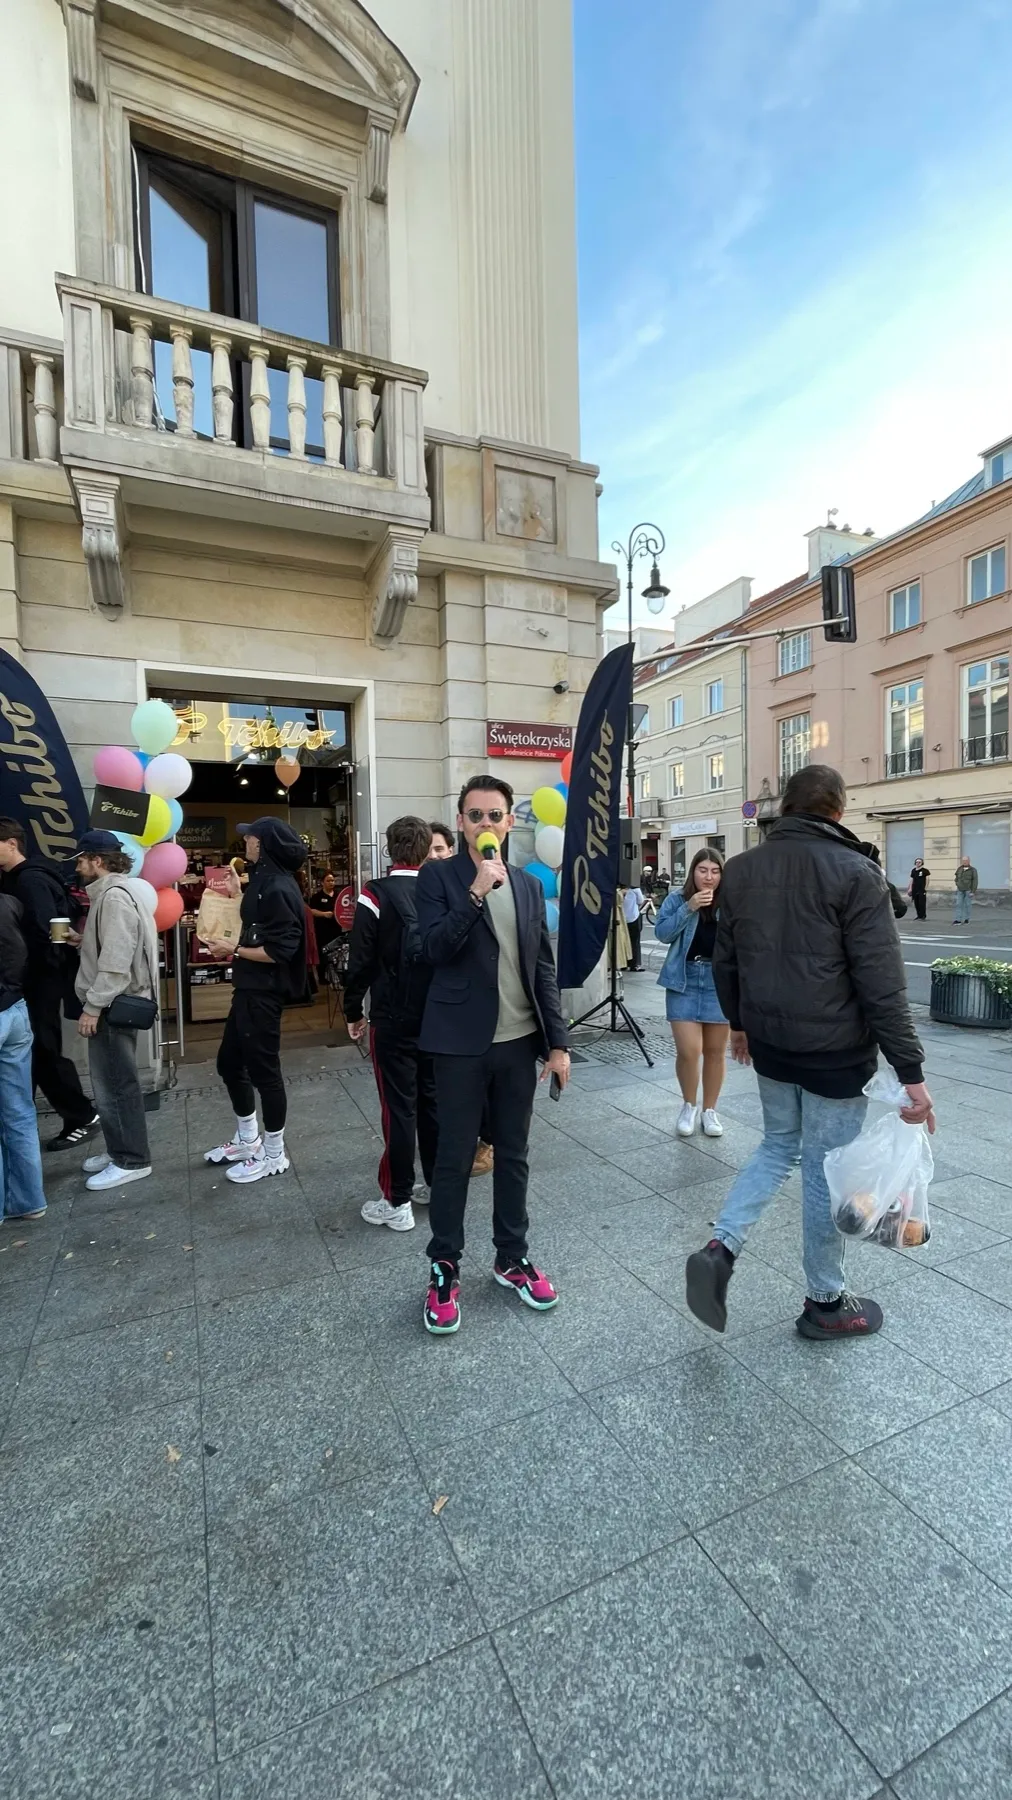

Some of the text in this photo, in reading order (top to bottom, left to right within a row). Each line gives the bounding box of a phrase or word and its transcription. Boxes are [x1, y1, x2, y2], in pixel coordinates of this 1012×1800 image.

[218, 716, 337, 750] Tchibo
[490, 728, 571, 750] Świętokrzyska
[0, 692, 78, 862] Tchibo
[586, 709, 614, 859] Tchibo
[112, 806, 139, 818] Tchibo
